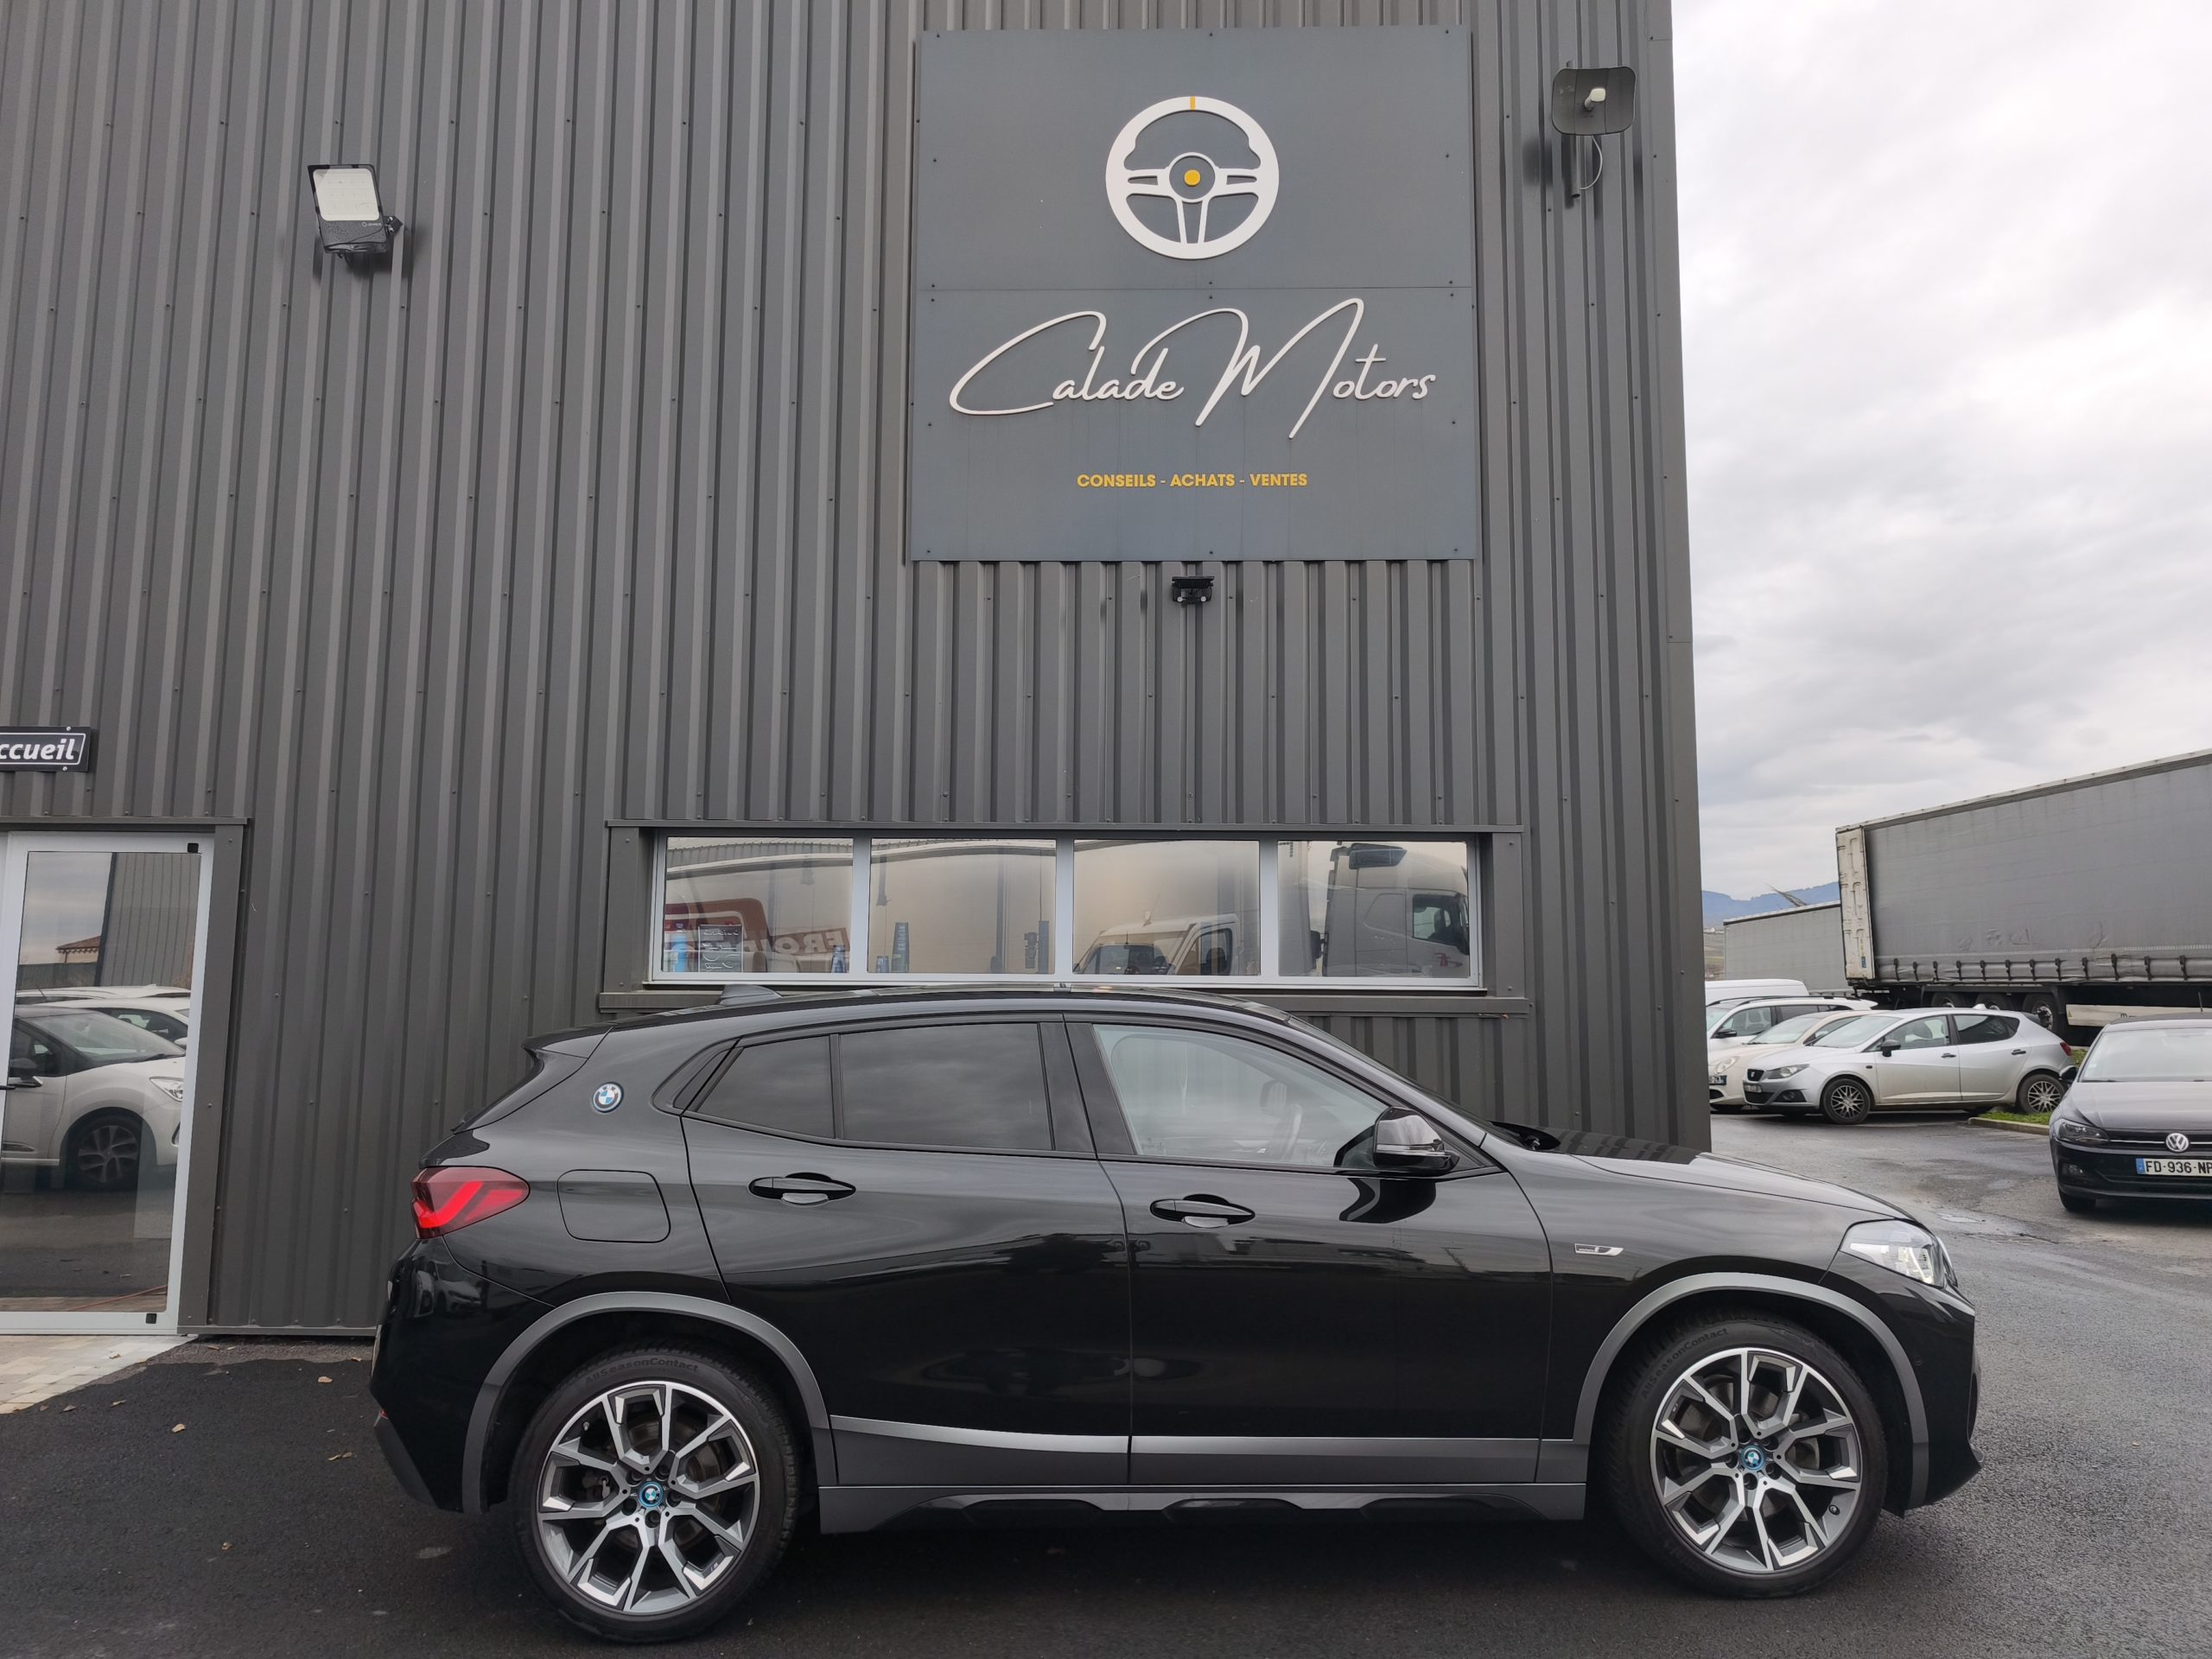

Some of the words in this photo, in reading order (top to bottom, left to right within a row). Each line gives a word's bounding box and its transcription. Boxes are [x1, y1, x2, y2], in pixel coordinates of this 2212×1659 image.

[950, 310, 1185, 416] Calade
[1130, 297, 1436, 440] Motors
[1077, 474, 1156, 487] CONSEILS
[1170, 474, 1236, 487] ACHATS
[1249, 473, 1308, 486] VENTES
[0, 738, 75, 760] ccueil
[585, 1357, 699, 1384] AllSeasonContact
[1641, 1328, 1728, 1399] AllSeasonContact
